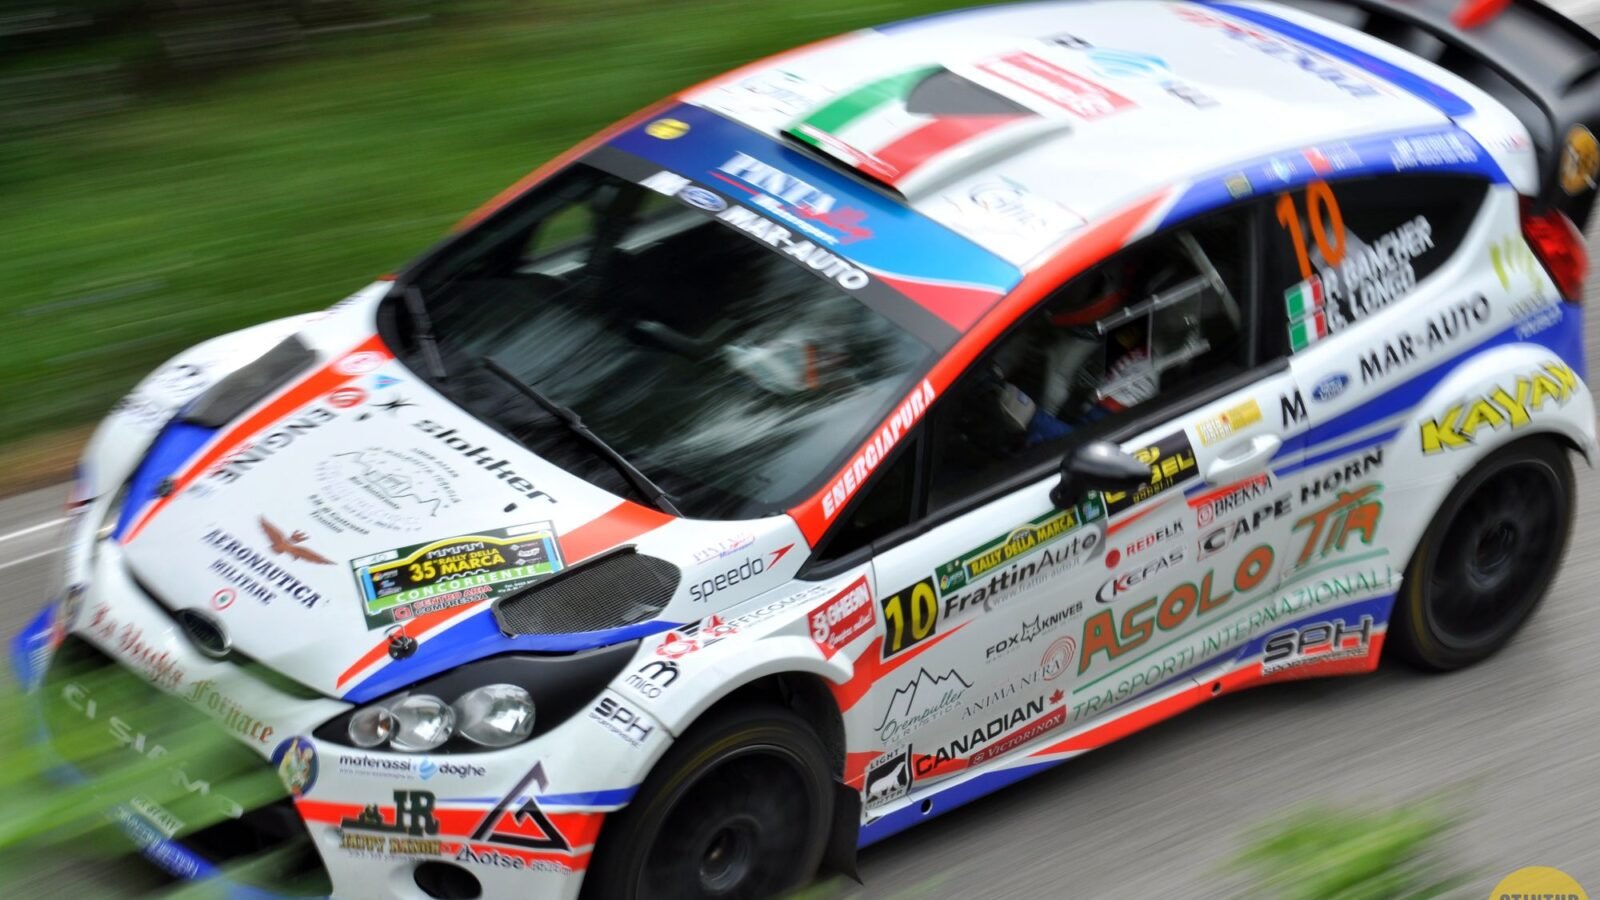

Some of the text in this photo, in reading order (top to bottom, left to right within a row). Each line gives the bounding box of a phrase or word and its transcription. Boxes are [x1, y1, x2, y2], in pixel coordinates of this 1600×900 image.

[716, 204, 869, 290] MAR-AUTO
[1276, 180, 1346, 281] 10
[1281, 387, 1308, 428] M
[1358, 293, 1491, 384] MAR-AUTO
[208, 407, 339, 485] ENGINE
[411, 418, 559, 505] slokker
[821, 377, 936, 520] ENERGIAPURA
[1203, 444, 1386, 553] CAPE HORN
[1214, 475, 1273, 516] BREKKA
[200, 527, 322, 610] AERONAUTICA
[440, 554, 506, 576] MARCA
[969, 513, 1077, 577] RALLY DELLA MARCA
[1126, 519, 1184, 557] REDELK
[209, 558, 279, 606] MILITARE
[396, 565, 537, 602] CONCORRENTE
[689, 556, 765, 603] speedo
[1077, 544, 1276, 676] ASOLO
[884, 583, 935, 653] 10
[986, 633, 1019, 659] FOX
[1042, 600, 1084, 630] KNIVES
[1073, 564, 1393, 721] TRASPORTI INTERNAZIONALI
[1263, 614, 1373, 664] SPH
[184, 679, 275, 743] Fornace
[594, 696, 656, 742] SPH
[961, 683, 1016, 721] ANIMA
[339, 754, 486, 779] materassi doghe
[869, 748, 900, 771] LIGHT
[915, 695, 1045, 777] CANADIAN
[987, 713, 1062, 758] VICTORINOX
